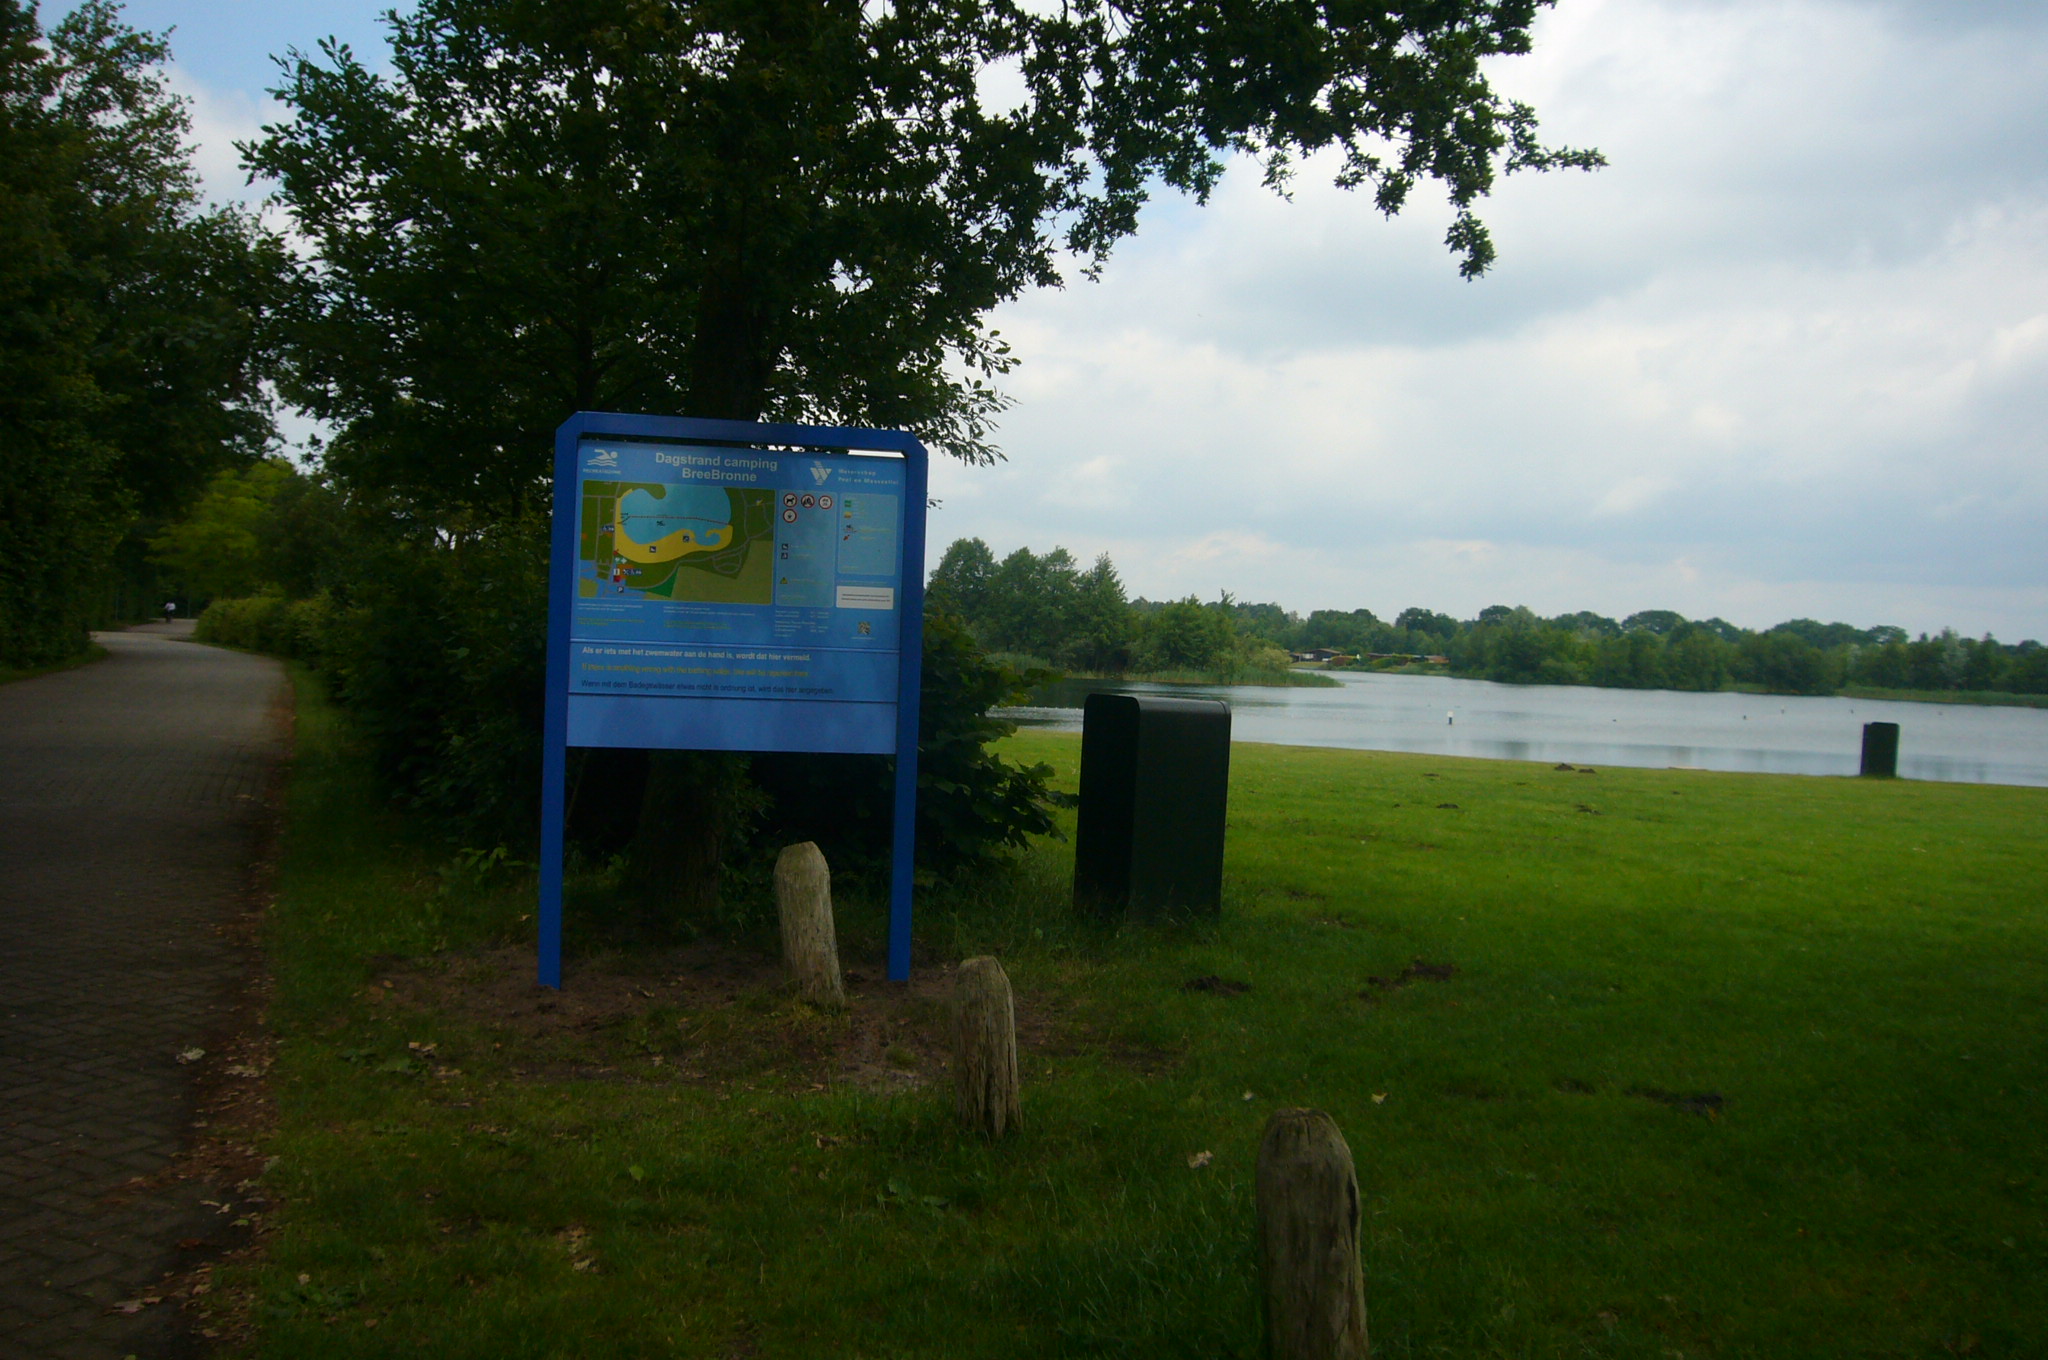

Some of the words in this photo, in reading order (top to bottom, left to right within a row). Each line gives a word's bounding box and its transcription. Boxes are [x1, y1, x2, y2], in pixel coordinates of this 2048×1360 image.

[655, 452, 720, 466] Dagstrand
[724, 457, 777, 471] camping
[681, 467, 757, 481] BreeBronne
[582, 646, 594, 654] Als
